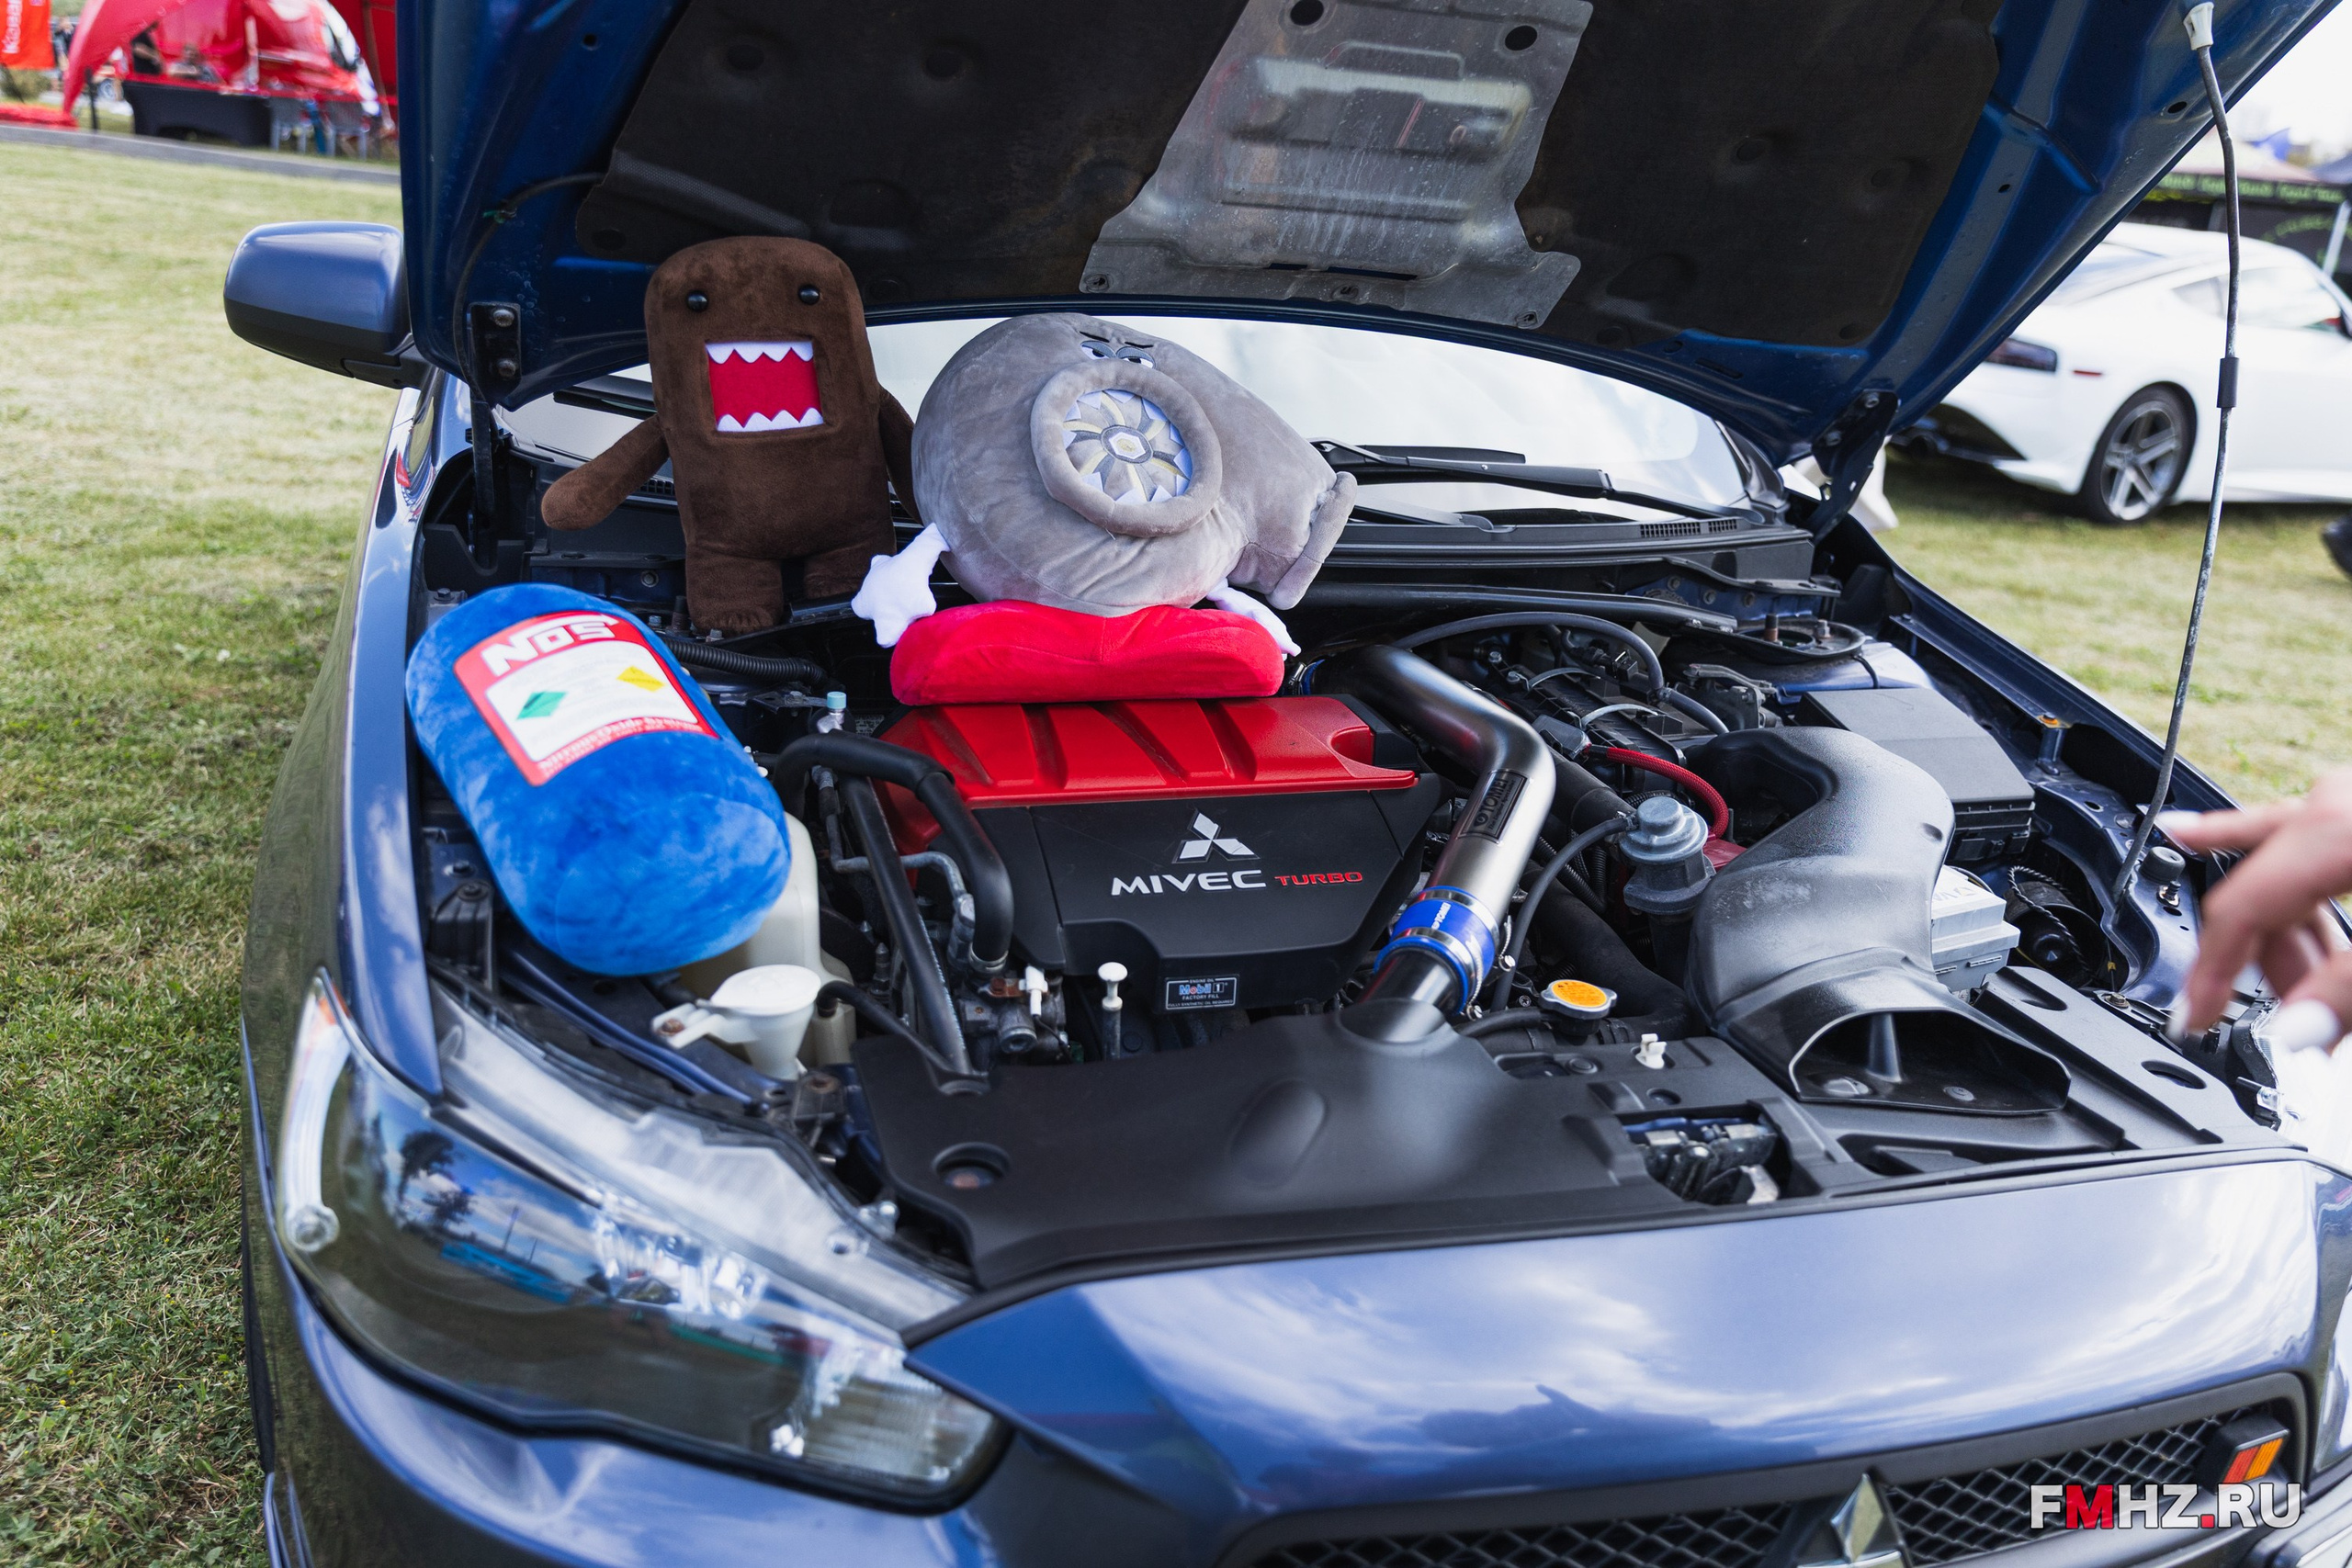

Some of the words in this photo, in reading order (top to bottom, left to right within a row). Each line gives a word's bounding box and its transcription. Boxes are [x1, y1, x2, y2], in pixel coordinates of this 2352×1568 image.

[481, 614, 619, 677] NOS
[1478, 778, 1509, 813] TOMEI
[1111, 869, 1267, 896] MIVEC
[1274, 871, 1363, 887] TURBO
[1179, 983, 1212, 995] Mobil
